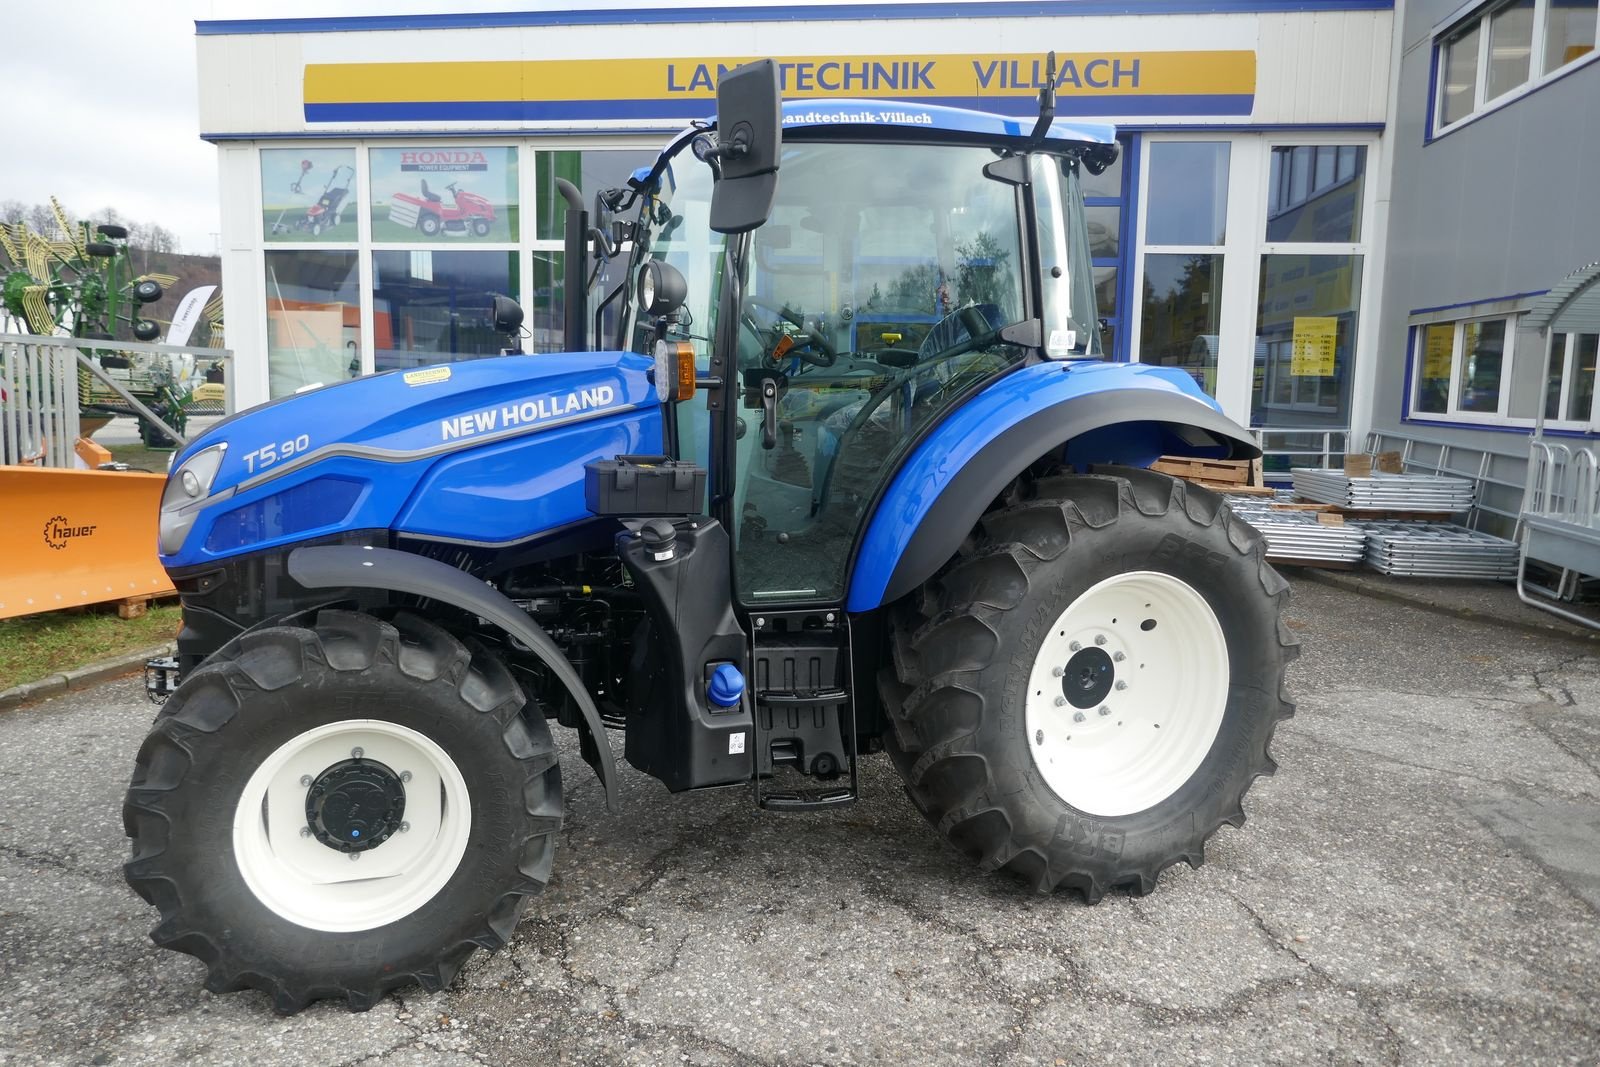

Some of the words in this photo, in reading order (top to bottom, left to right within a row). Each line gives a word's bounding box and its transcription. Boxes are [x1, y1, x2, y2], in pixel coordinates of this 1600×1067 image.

[667, 61, 936, 92] LATECHNIK
[972, 58, 1140, 89] VILLACH
[781, 111, 933, 124] andtechnik-Villach
[401, 151, 488, 164] HONDA
[442, 409, 497, 440] NEW
[502, 385, 614, 426] HOLLAND
[243, 434, 309, 474] T5.90
[53, 523, 97, 539] hauer
